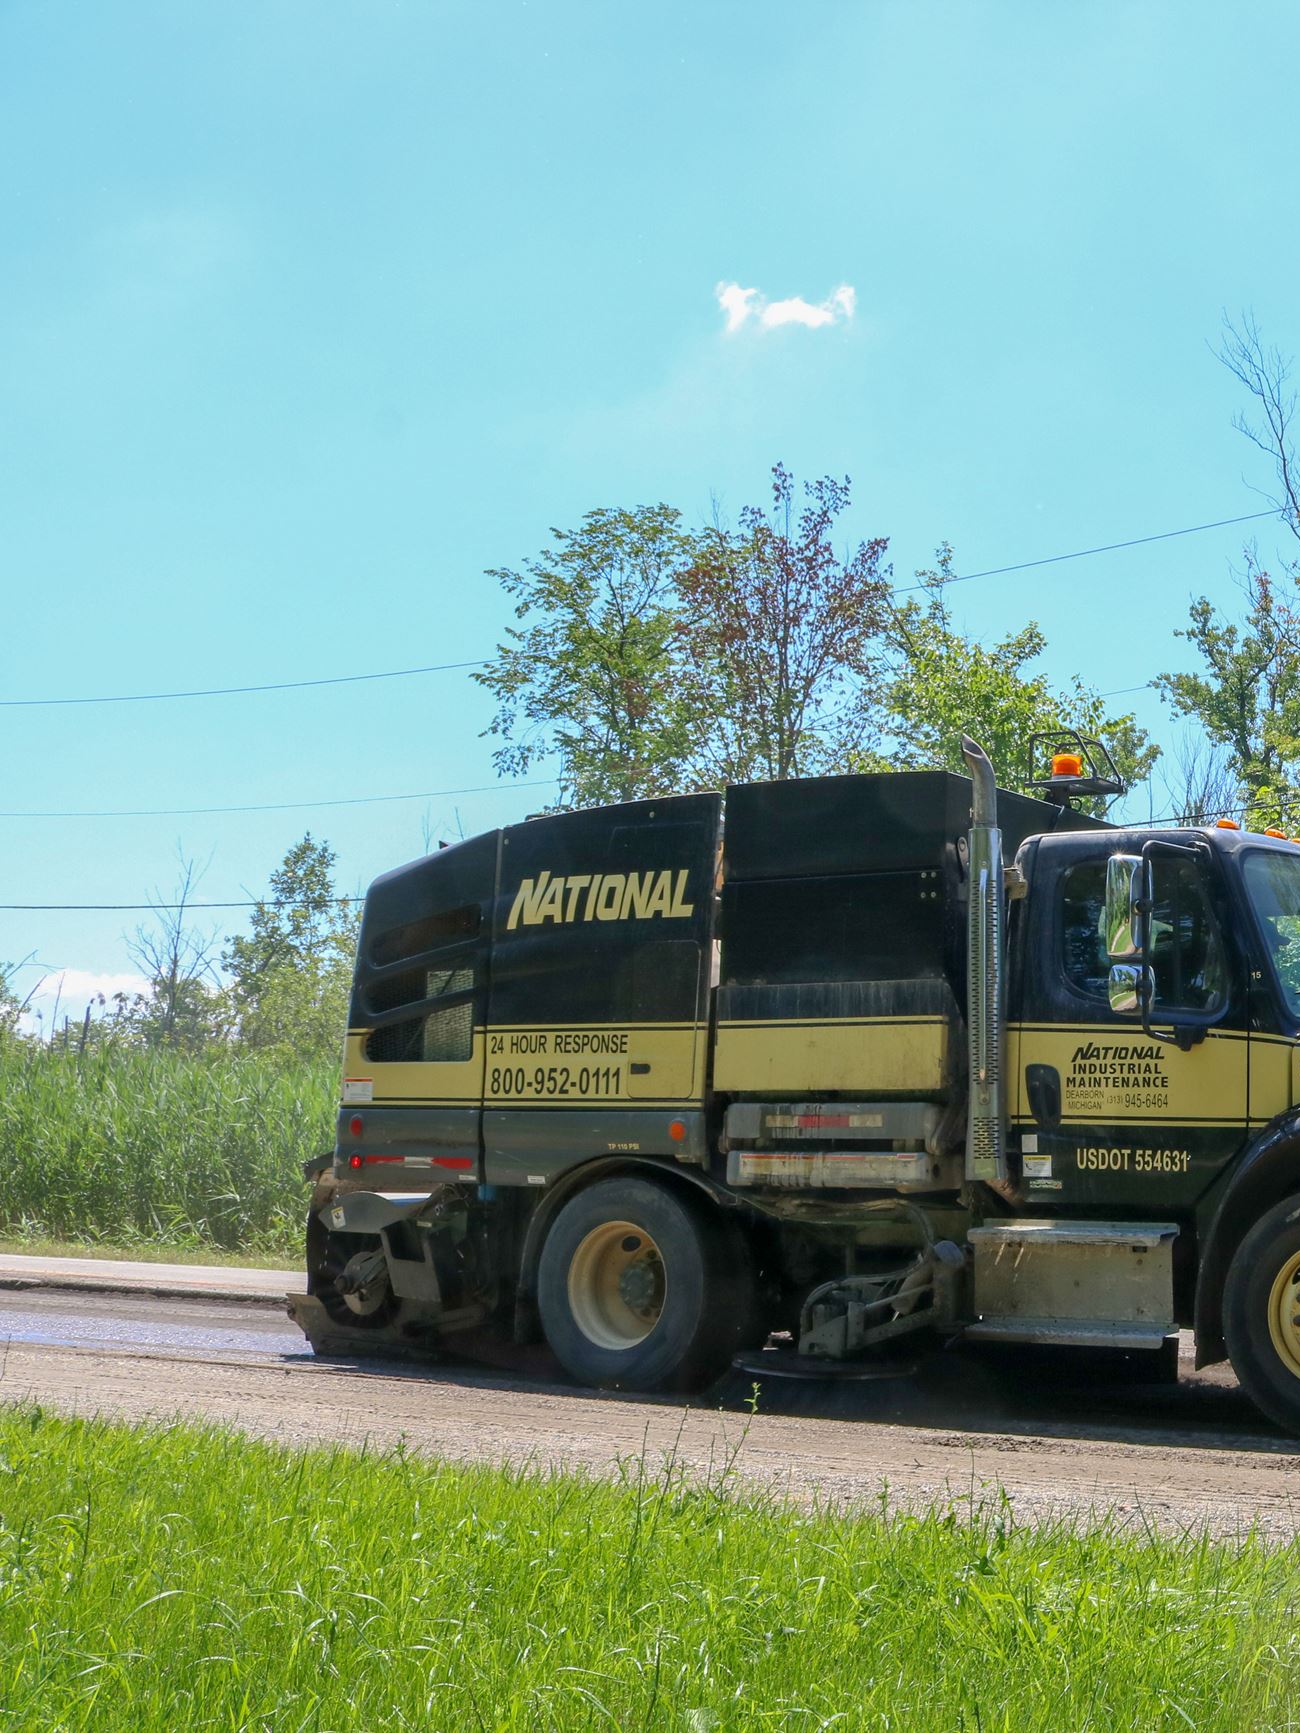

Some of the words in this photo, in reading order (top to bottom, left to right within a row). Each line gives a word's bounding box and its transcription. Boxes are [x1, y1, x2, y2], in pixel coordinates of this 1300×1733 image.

[506, 869, 694, 930] NATIONAL
[491, 1036, 504, 1054] 24
[510, 1035, 547, 1054] HOUR
[554, 1034, 629, 1054] RESPONSE
[1071, 1042, 1165, 1063] NATIONAL
[1072, 1063, 1162, 1074] INDUSTRIAL
[491, 1067, 620, 1094] 800-952-0111
[1066, 1076, 1169, 1088] MAINTENANCE
[1065, 1090, 1104, 1099] DEARBORN
[1124, 1093, 1168, 1108] 945-6464
[1068, 1101, 1102, 1110] MICHIGAN
[1077, 1148, 1131, 1170] USDOT
[1135, 1150, 1187, 1172] 554631
